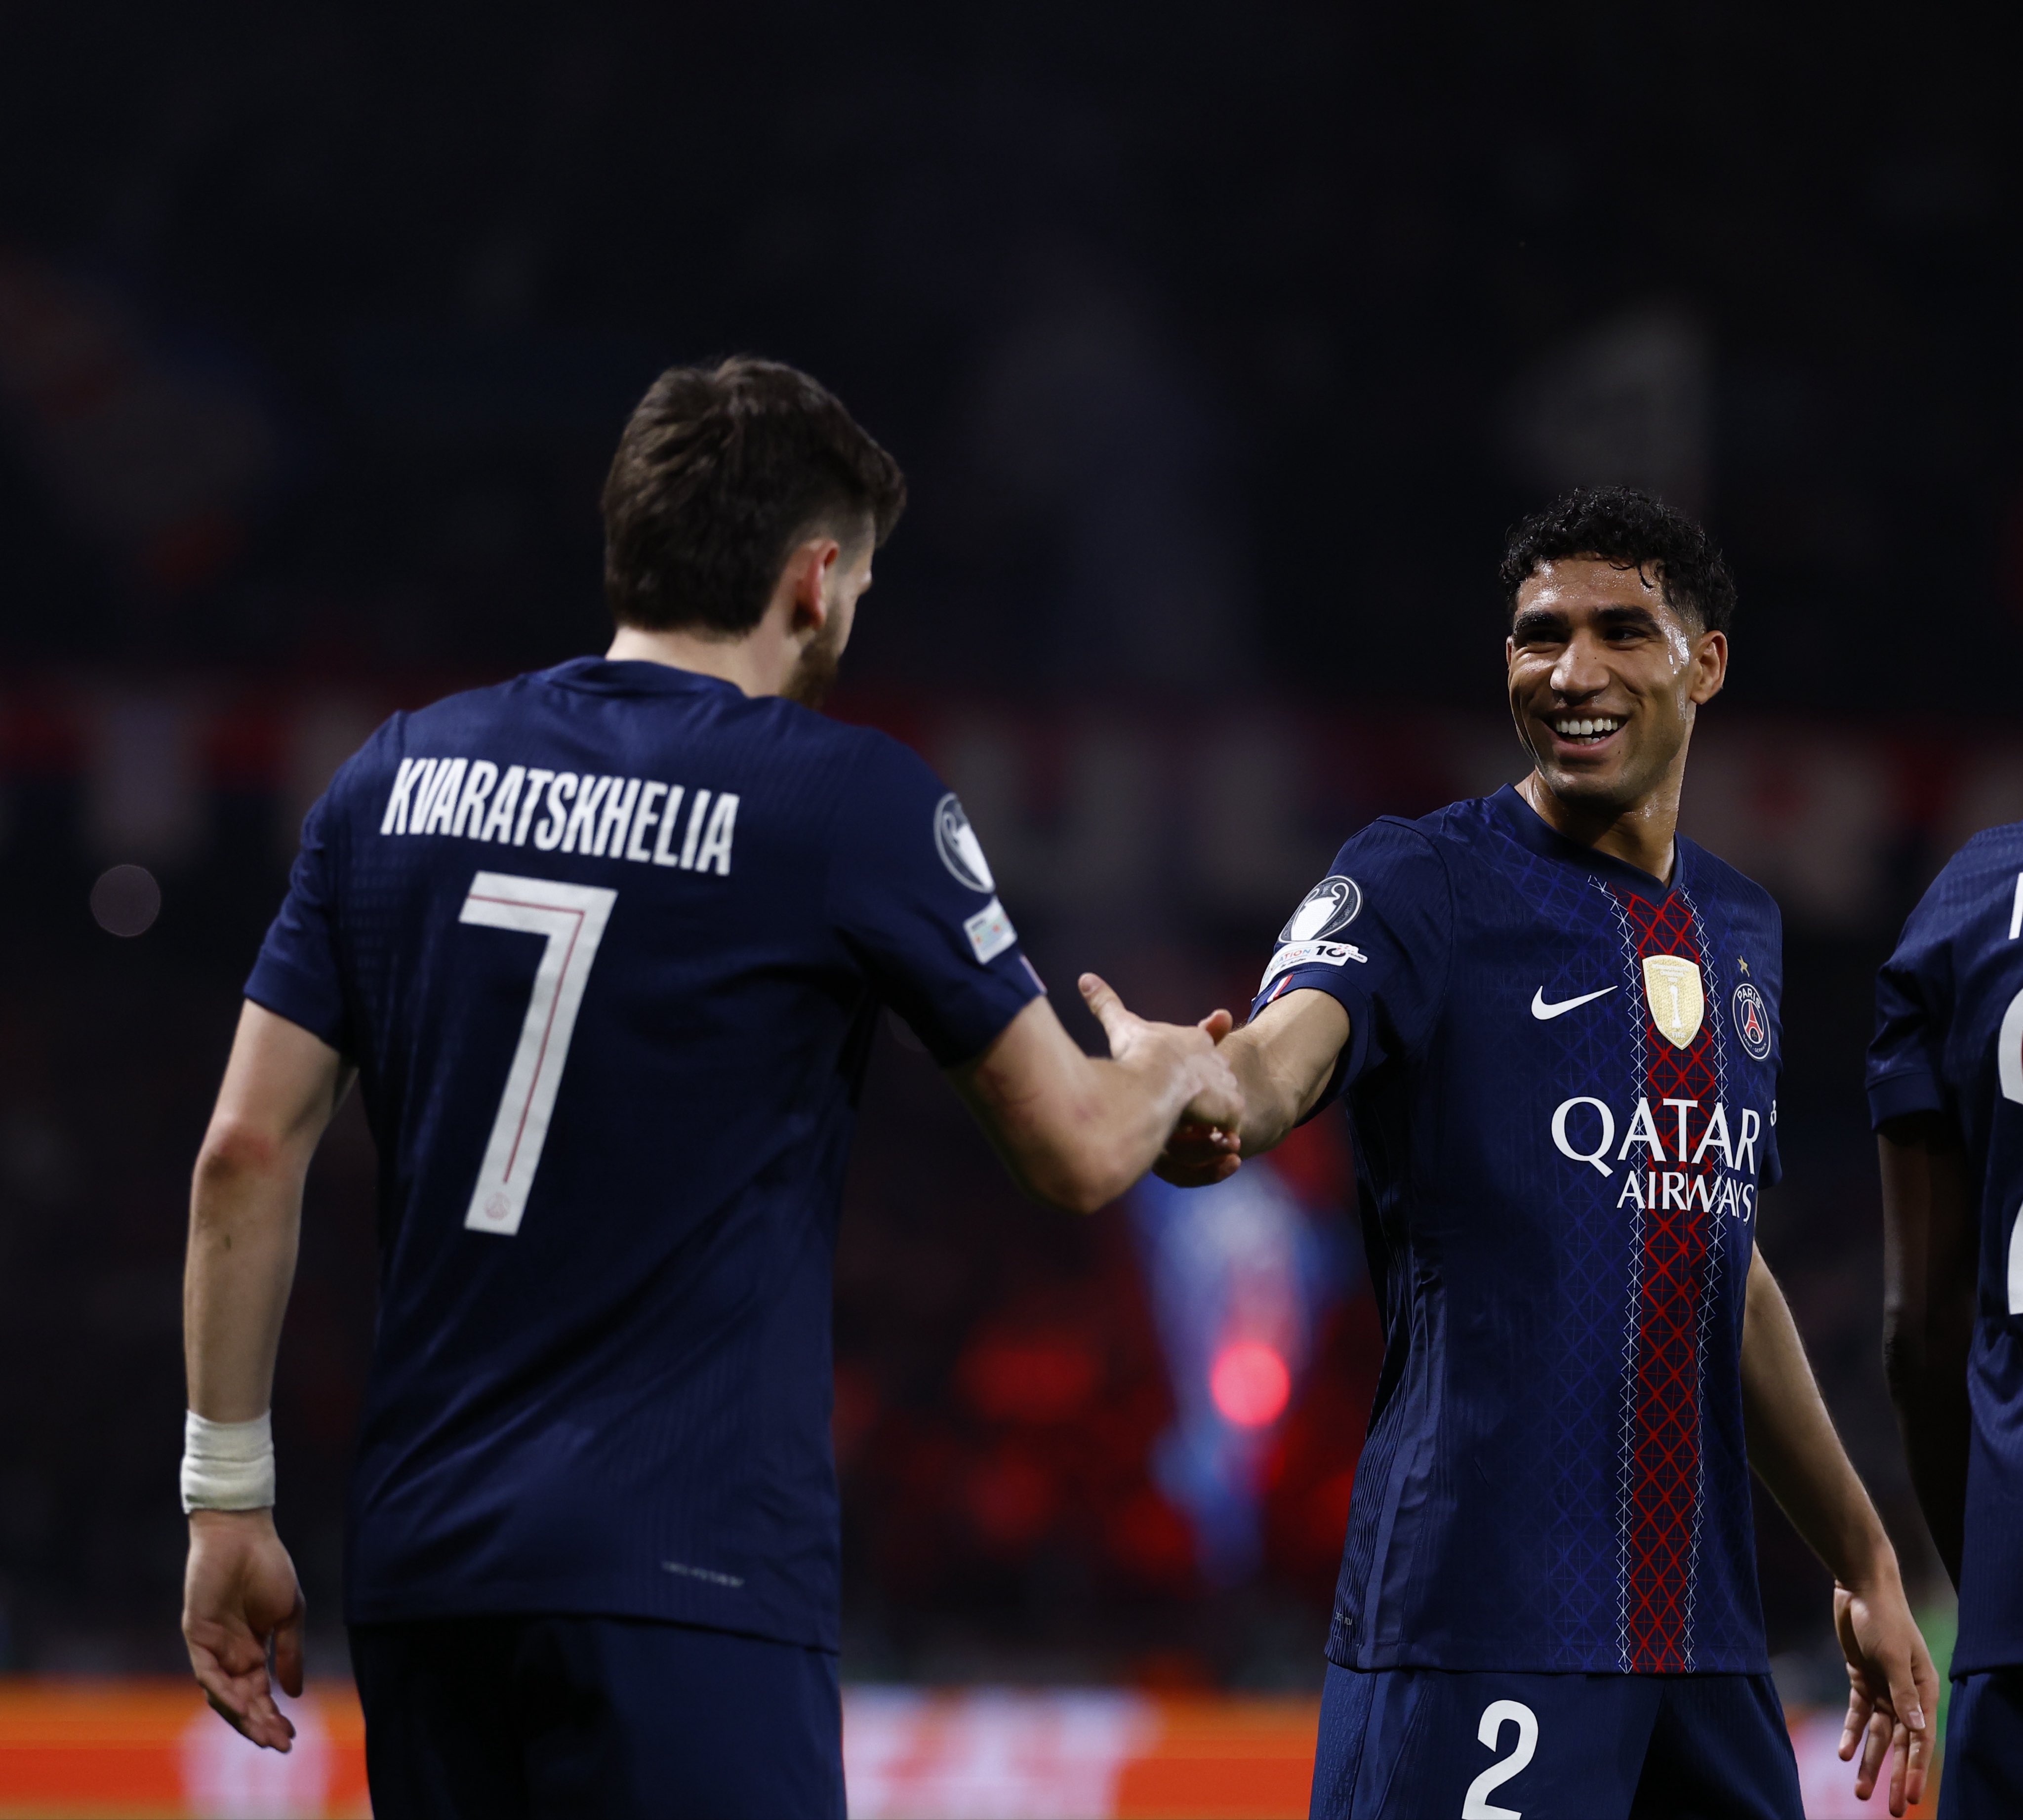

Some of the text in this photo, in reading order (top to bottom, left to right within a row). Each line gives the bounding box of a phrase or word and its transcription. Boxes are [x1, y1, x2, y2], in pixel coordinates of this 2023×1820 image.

[380, 757, 740, 876] KVARATSKHELIA
[1737, 987, 1762, 1009] PARIS
[457, 870, 618, 1236] 7
[1551, 1096, 1761, 1177] QATAR
[1617, 1170, 1754, 1223] AIRWAYS
[1461, 1699, 1539, 1820] 2
